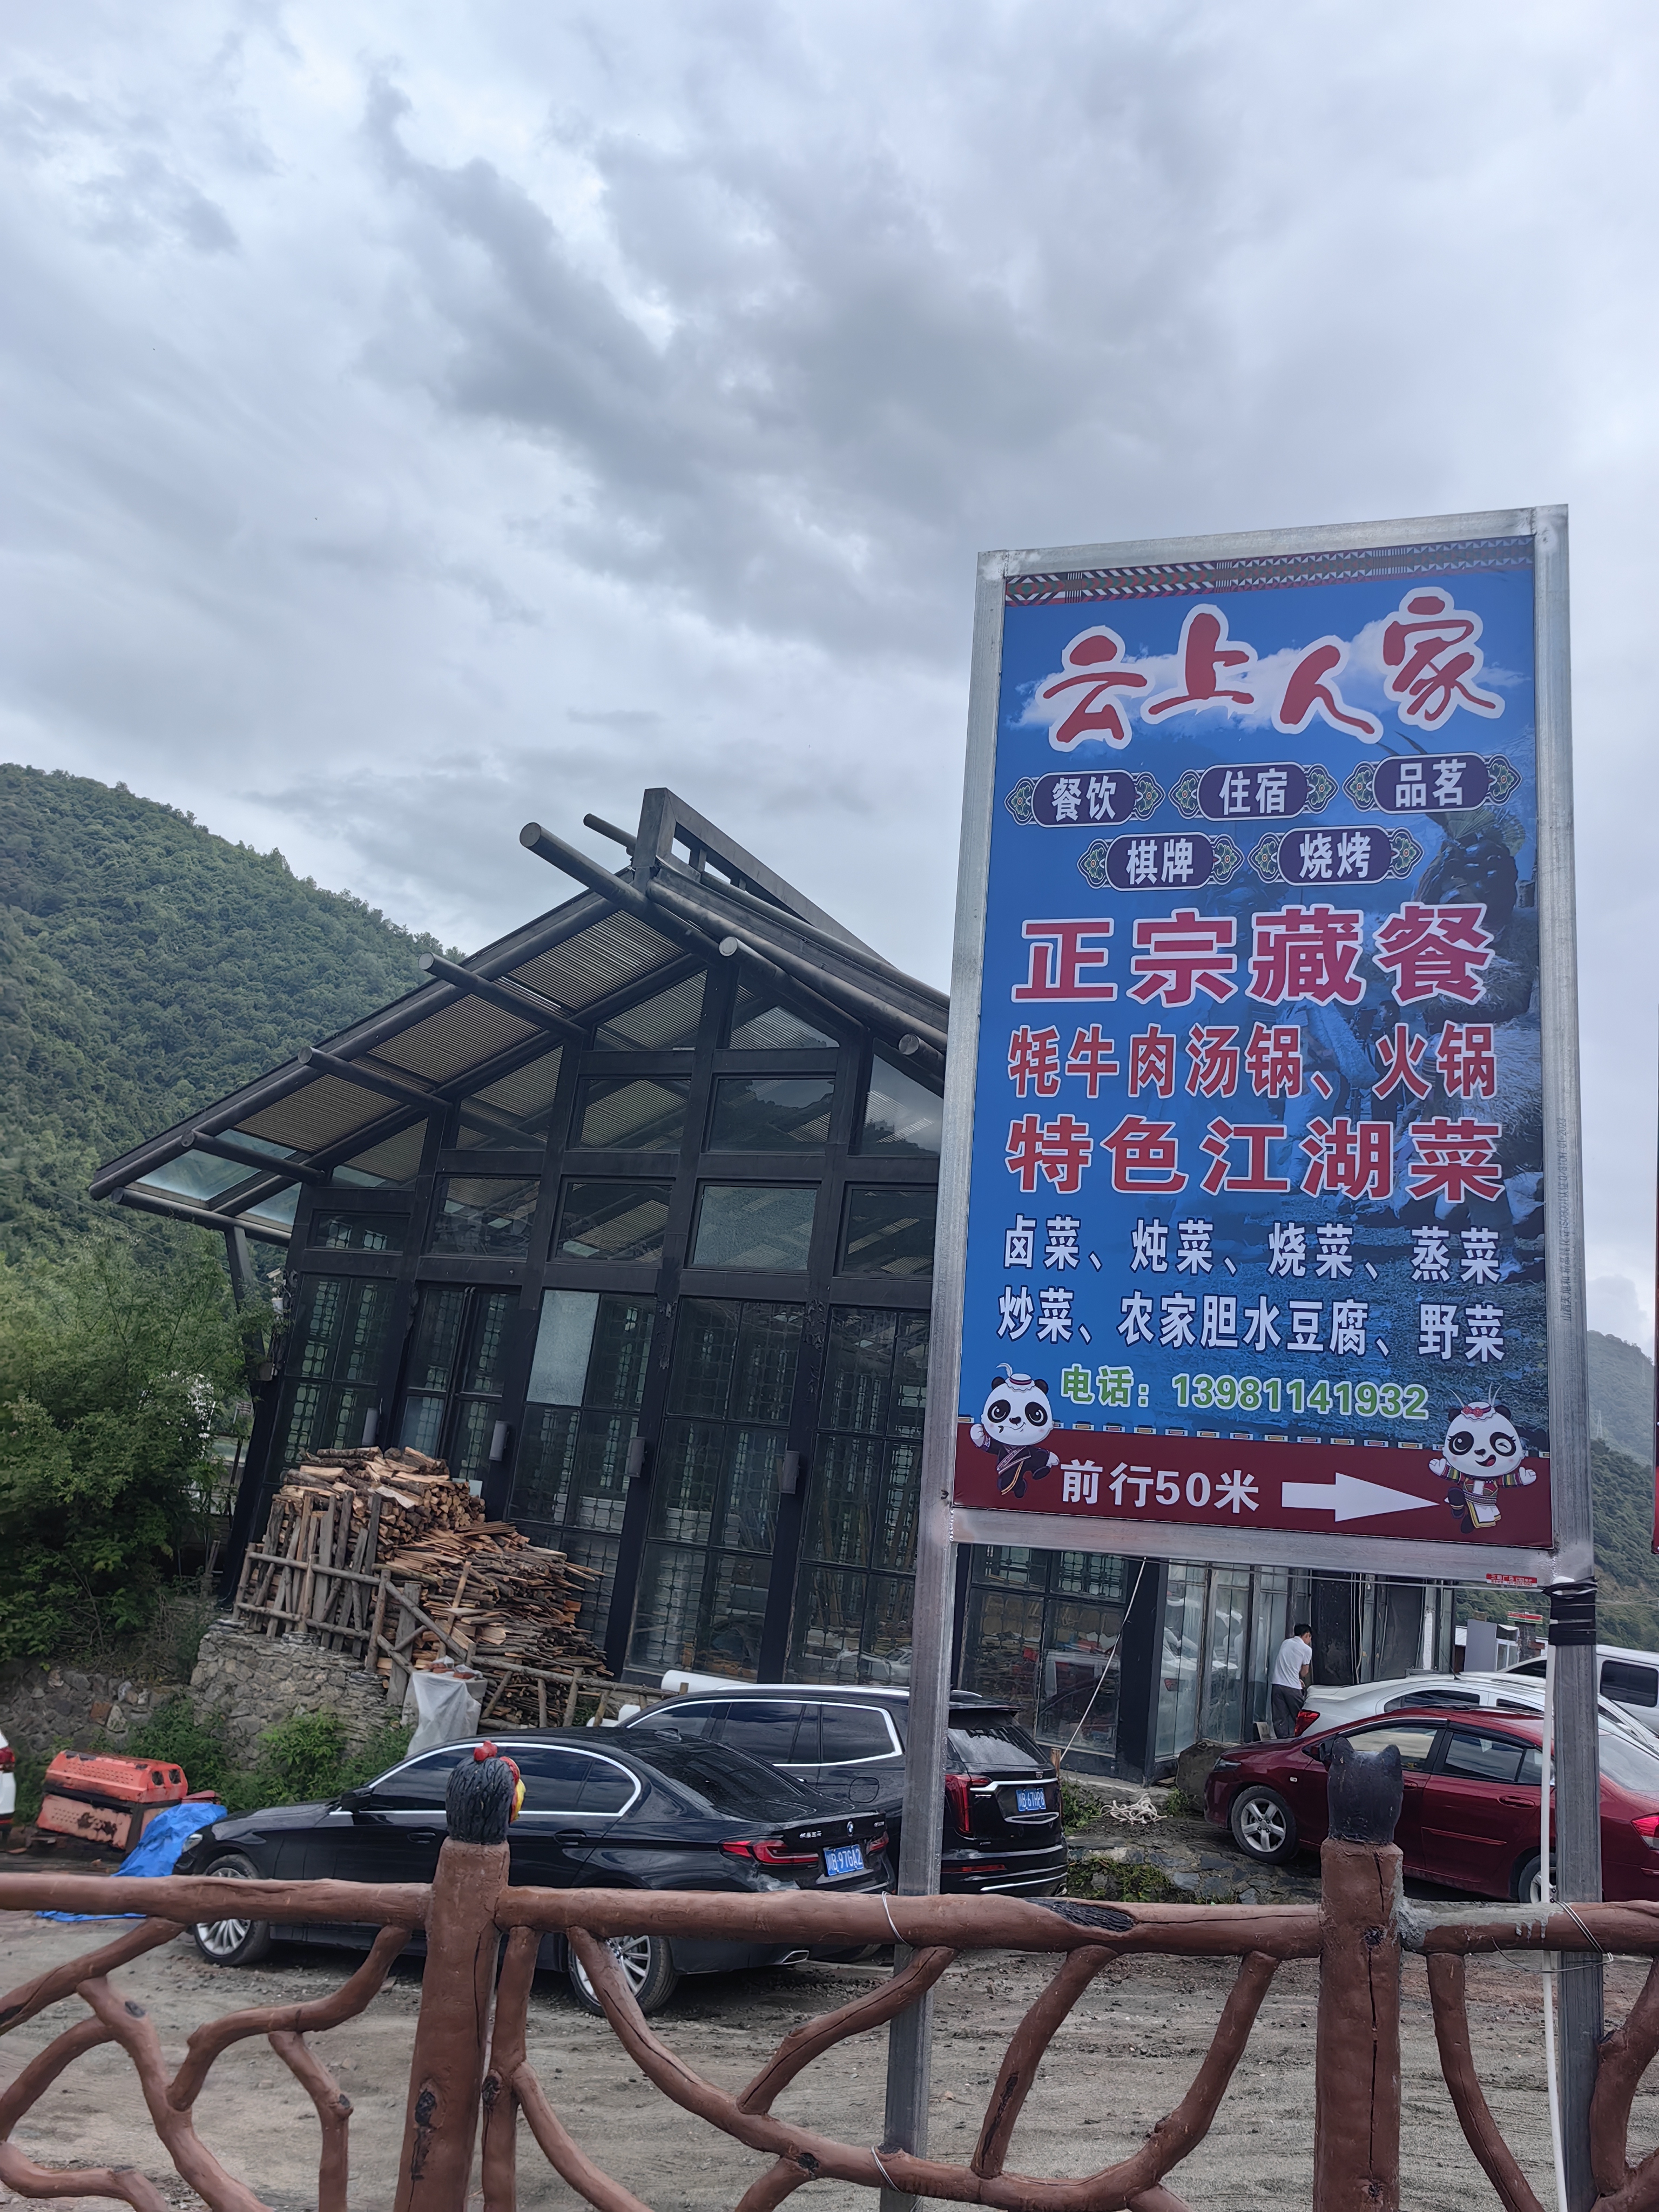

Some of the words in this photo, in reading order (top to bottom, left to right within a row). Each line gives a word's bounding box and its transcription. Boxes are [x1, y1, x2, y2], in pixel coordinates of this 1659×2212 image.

[1036, 586, 1505, 753] 云上人家
[1051, 775, 1116, 823] 餐饮
[1220, 768, 1289, 815] 住宿
[1394, 759, 1467, 808] 品茗
[1125, 839, 1194, 886] 棋牌
[1299, 832, 1371, 880] 烧烤
[1011, 902, 1496, 1007] 正宗藏餐
[1006, 1019, 1498, 1100] 牦牛肉汤锅、火锅
[1003, 1113, 1506, 1203] 特色江湖菜
[1060, 1459, 1259, 1512] 前行50米
